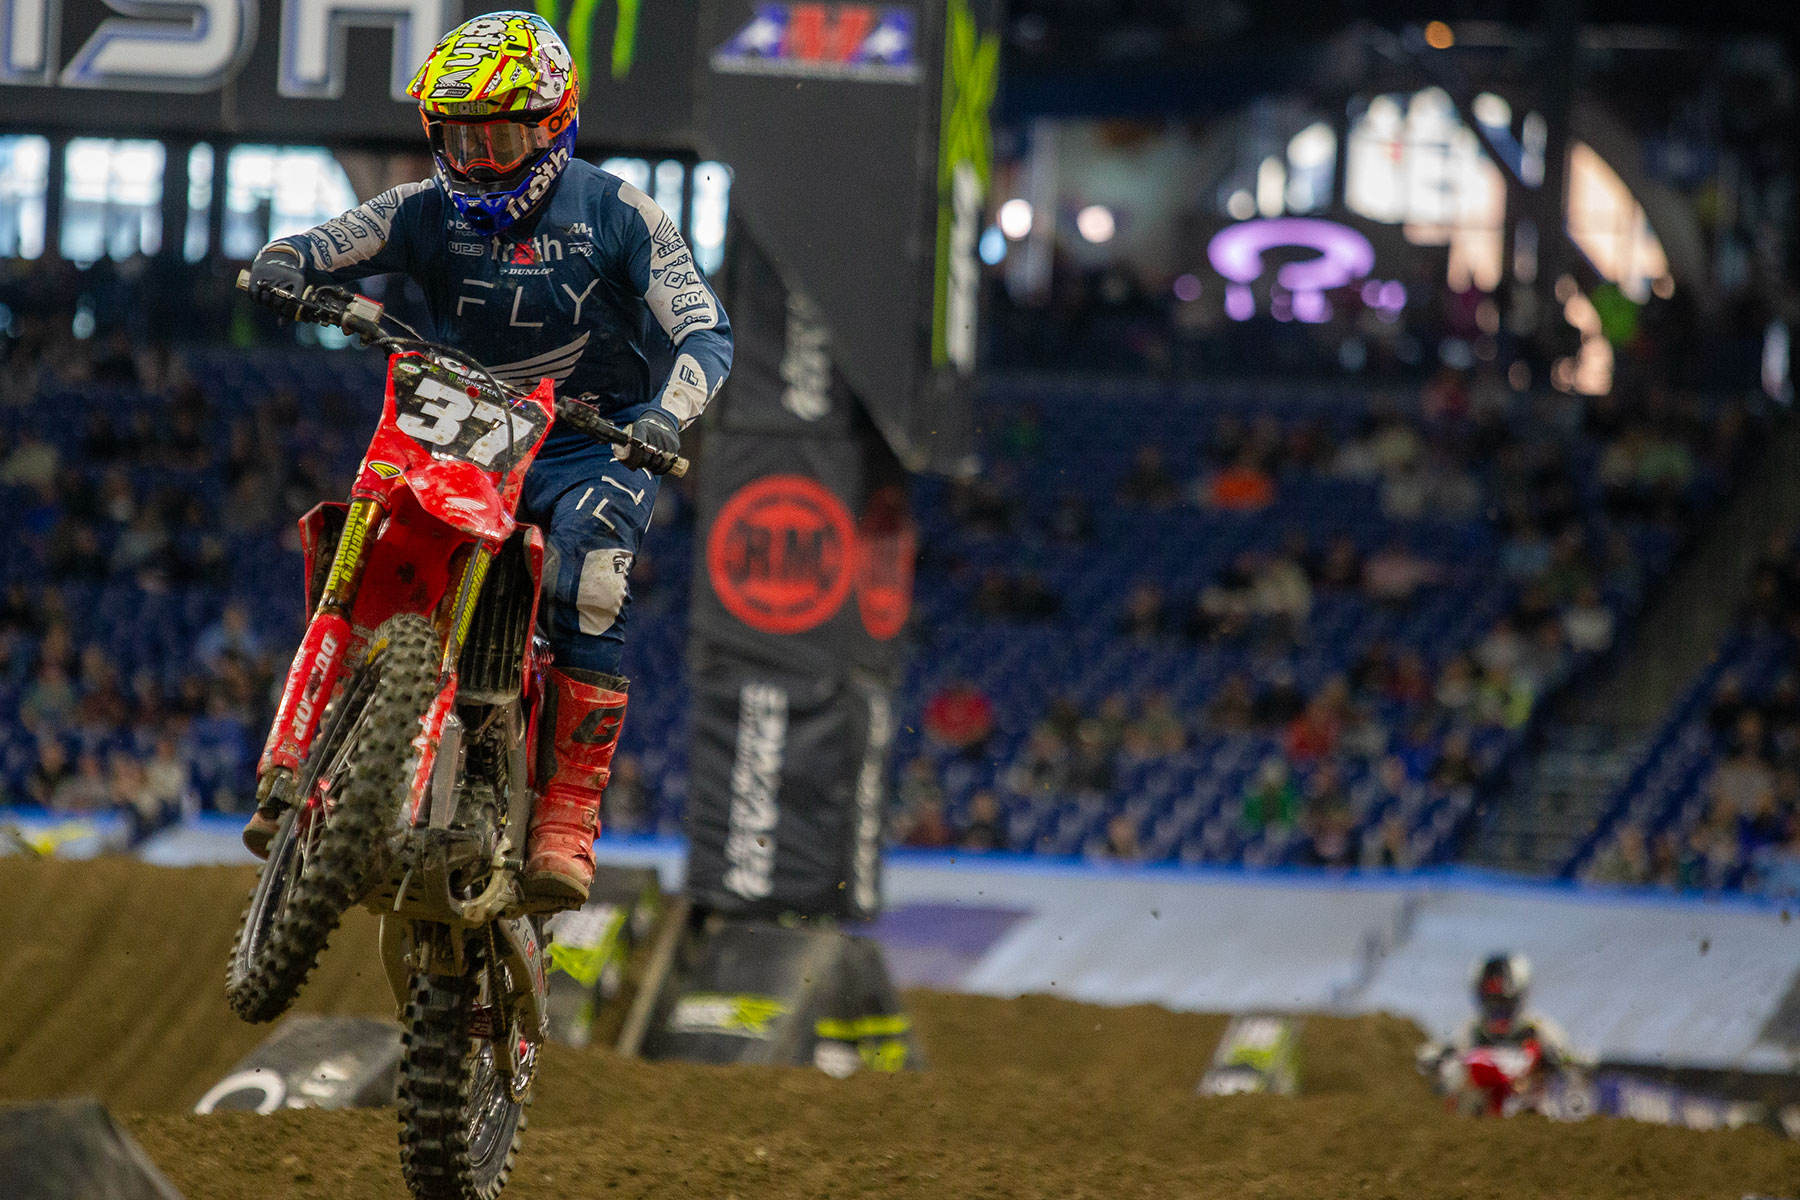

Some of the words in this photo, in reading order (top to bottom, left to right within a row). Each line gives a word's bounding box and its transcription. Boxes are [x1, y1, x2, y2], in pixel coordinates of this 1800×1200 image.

[508, 268, 554, 276] DUNLOP
[456, 278, 600, 327] FLY
[456, 375, 498, 398] MONSTER
[396, 376, 534, 467] 37
[291, 629, 339, 742] DUOP
